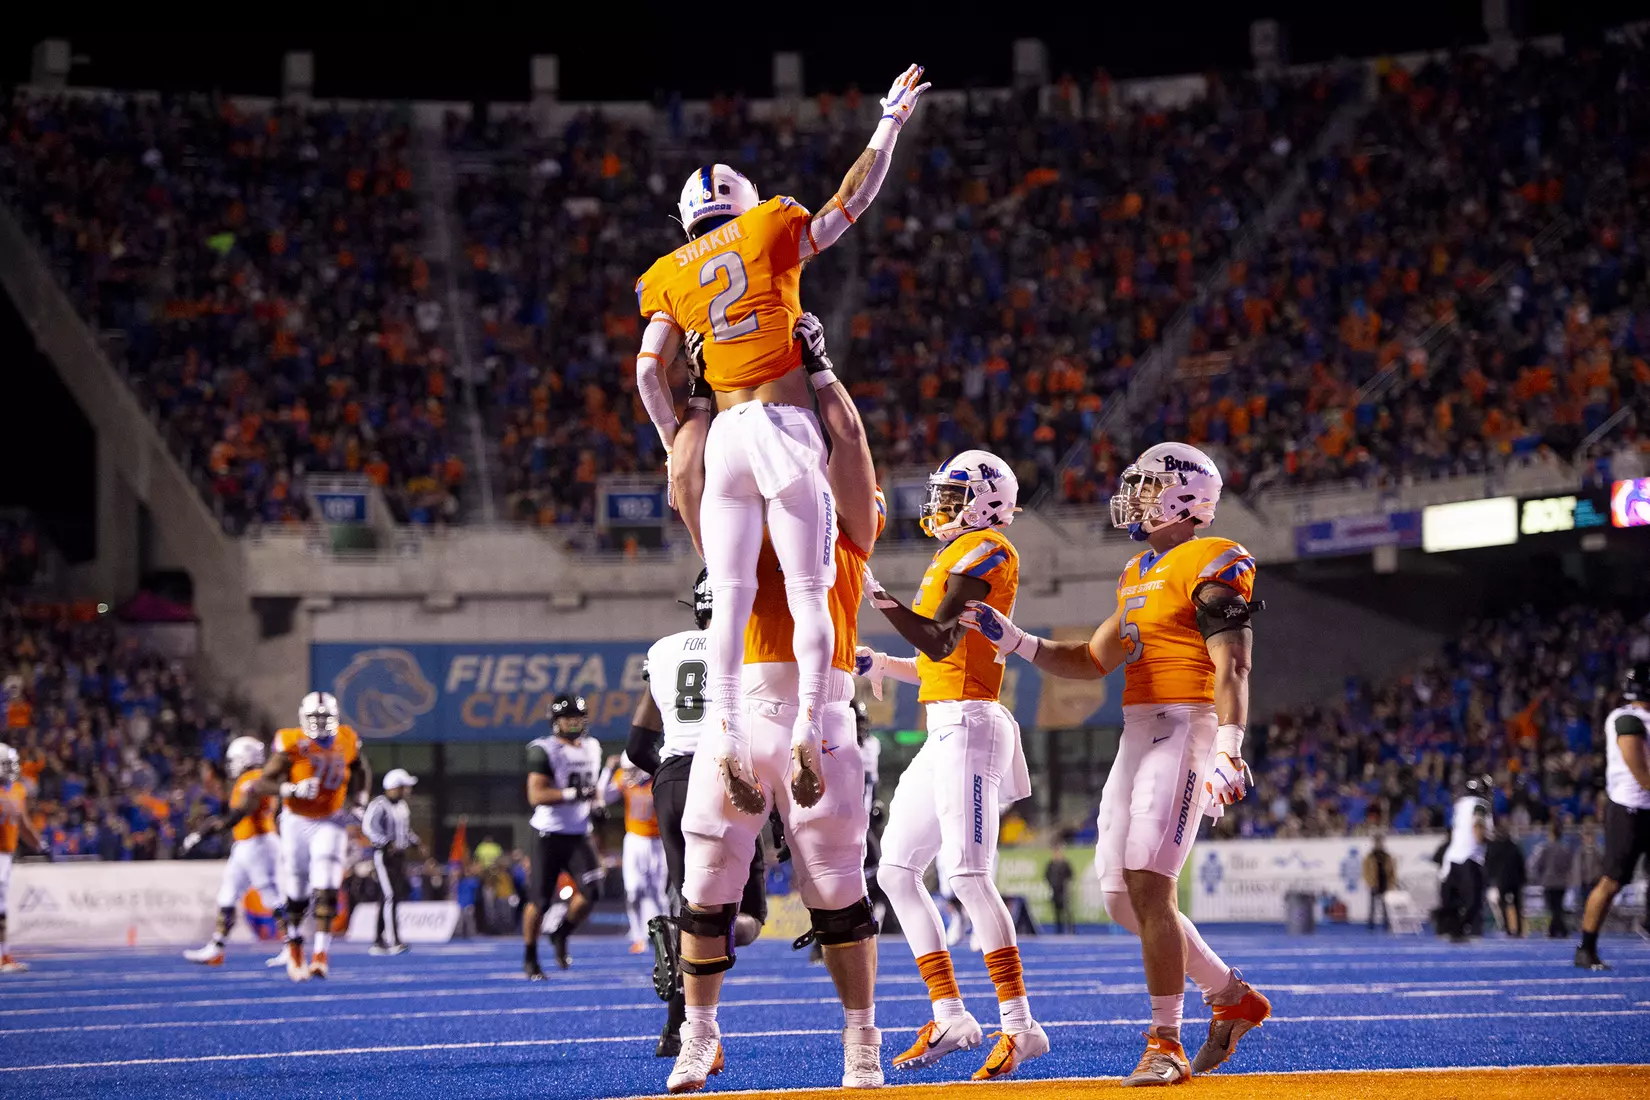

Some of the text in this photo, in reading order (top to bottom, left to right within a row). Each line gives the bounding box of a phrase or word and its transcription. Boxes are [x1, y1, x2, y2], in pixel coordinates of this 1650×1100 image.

[693, 204, 732, 218] BRONCOS
[676, 222, 741, 267] SHAKIR
[699, 250, 760, 342] 2
[822, 491, 833, 567] BRONCOS
[683, 637, 707, 651] FOR
[1119, 596, 1145, 664] 5
[445, 654, 608, 694] FIESTA
[675, 659, 708, 723] 8
[973, 774, 983, 845] BRONCOS
[1173, 769, 1197, 846] BRONCOS
